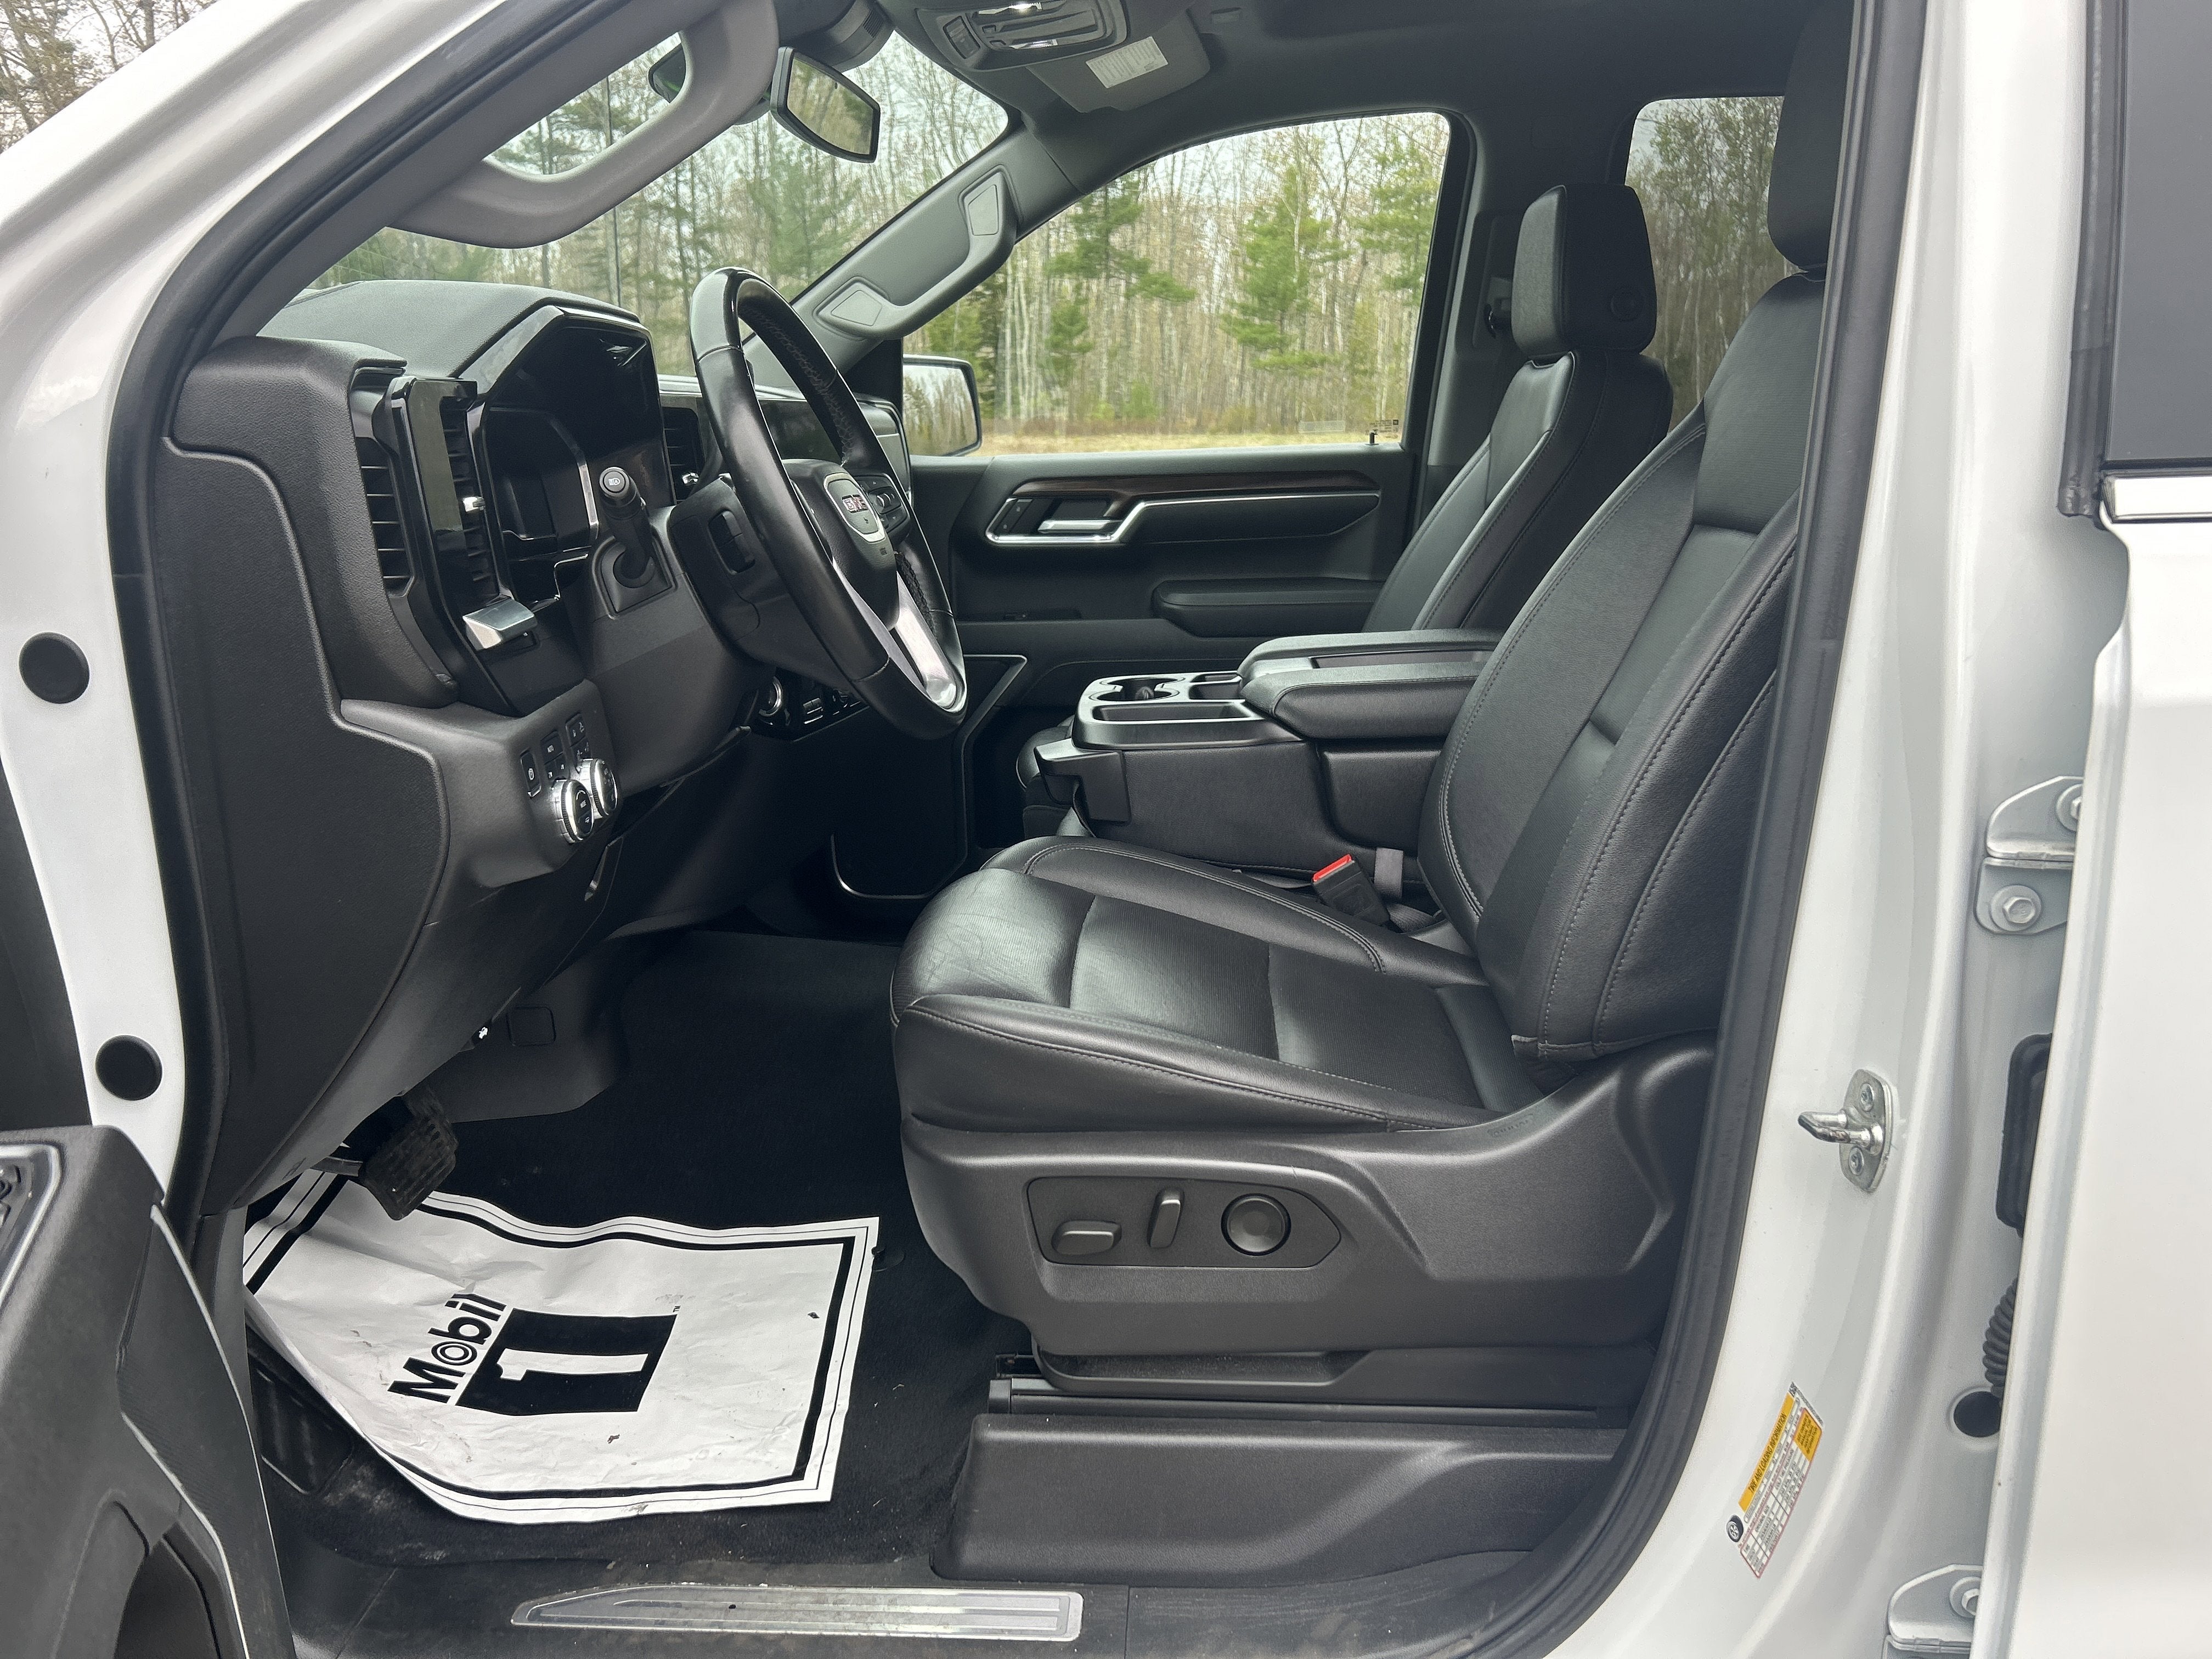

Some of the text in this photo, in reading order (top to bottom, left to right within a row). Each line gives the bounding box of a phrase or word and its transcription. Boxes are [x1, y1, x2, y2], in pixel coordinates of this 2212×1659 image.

[387, 1293, 507, 1404] Mobil
[496, 1347, 649, 1381] 1
[1760, 1446, 1773, 1470] LOADING
[1770, 1413, 1786, 1448] INFORMATION
